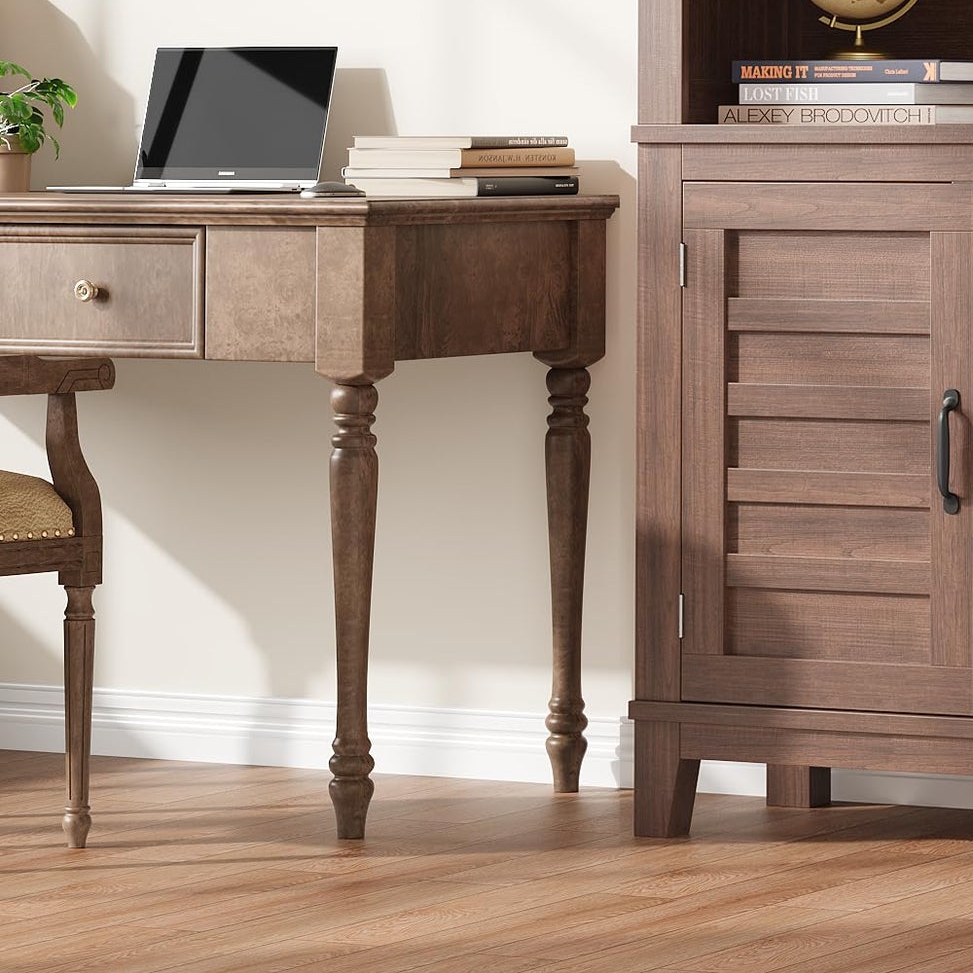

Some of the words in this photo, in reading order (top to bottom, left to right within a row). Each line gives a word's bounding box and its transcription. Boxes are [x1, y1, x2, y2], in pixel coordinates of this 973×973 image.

[740, 65, 793, 79] MAKING
[795, 65, 809, 79] IT
[743, 87, 783, 101] LOST
[785, 86, 819, 101] FISH
[723, 108, 794, 124] ALEXEY
[800, 107, 922, 124] BRODOVITCH
